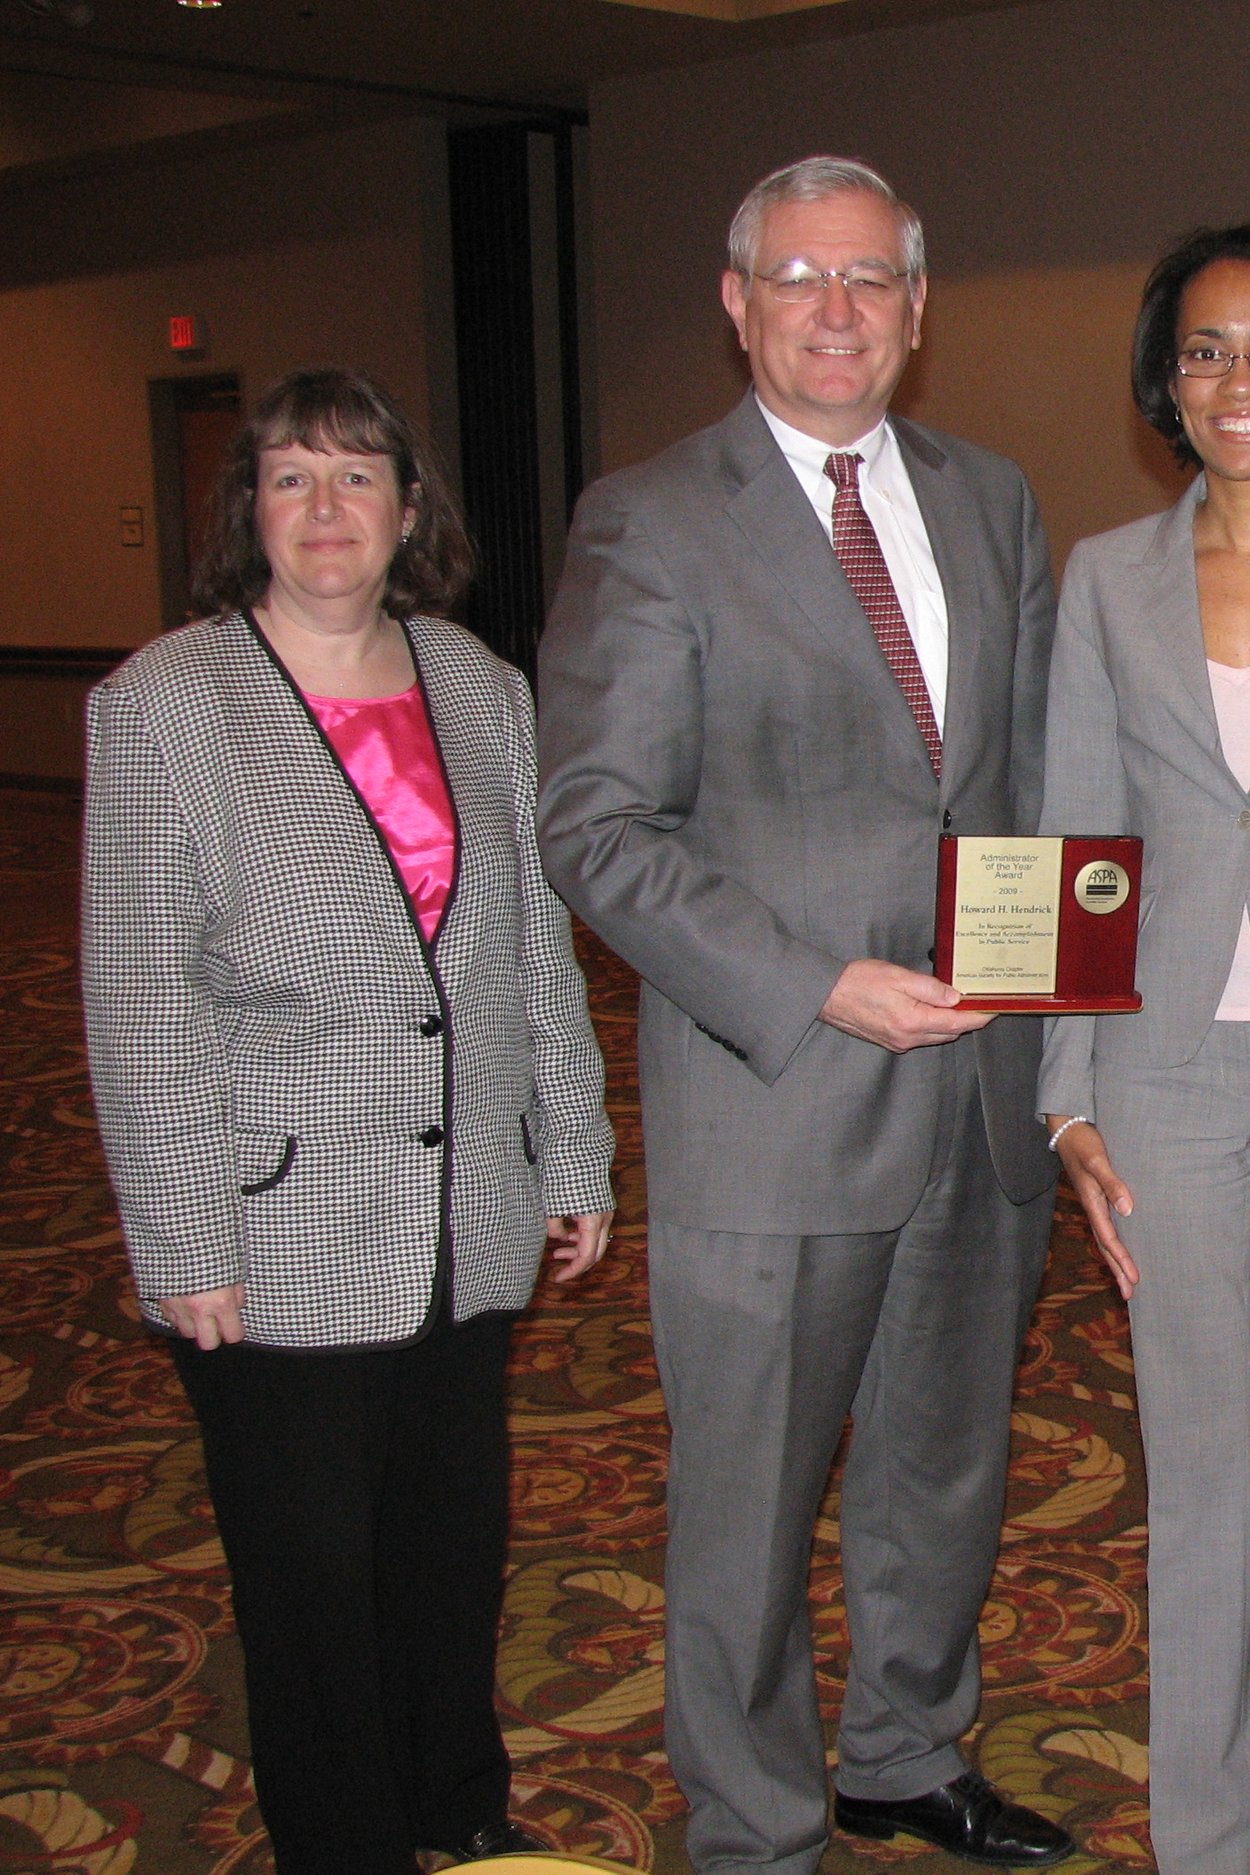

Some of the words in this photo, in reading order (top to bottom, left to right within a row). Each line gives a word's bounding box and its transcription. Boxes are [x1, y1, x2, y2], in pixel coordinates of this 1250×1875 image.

[980, 854, 1039, 862] Administrator
[985, 863, 994, 871] of
[996, 863, 1010, 871] the
[1012, 863, 1033, 871] Year
[994, 871, 1023, 879] Award
[1087, 869, 1118, 883] ASPA
[960, 904, 996, 914] Howard
[997, 904, 1008, 914] H.
[1010, 904, 1052, 914] Hendrick
